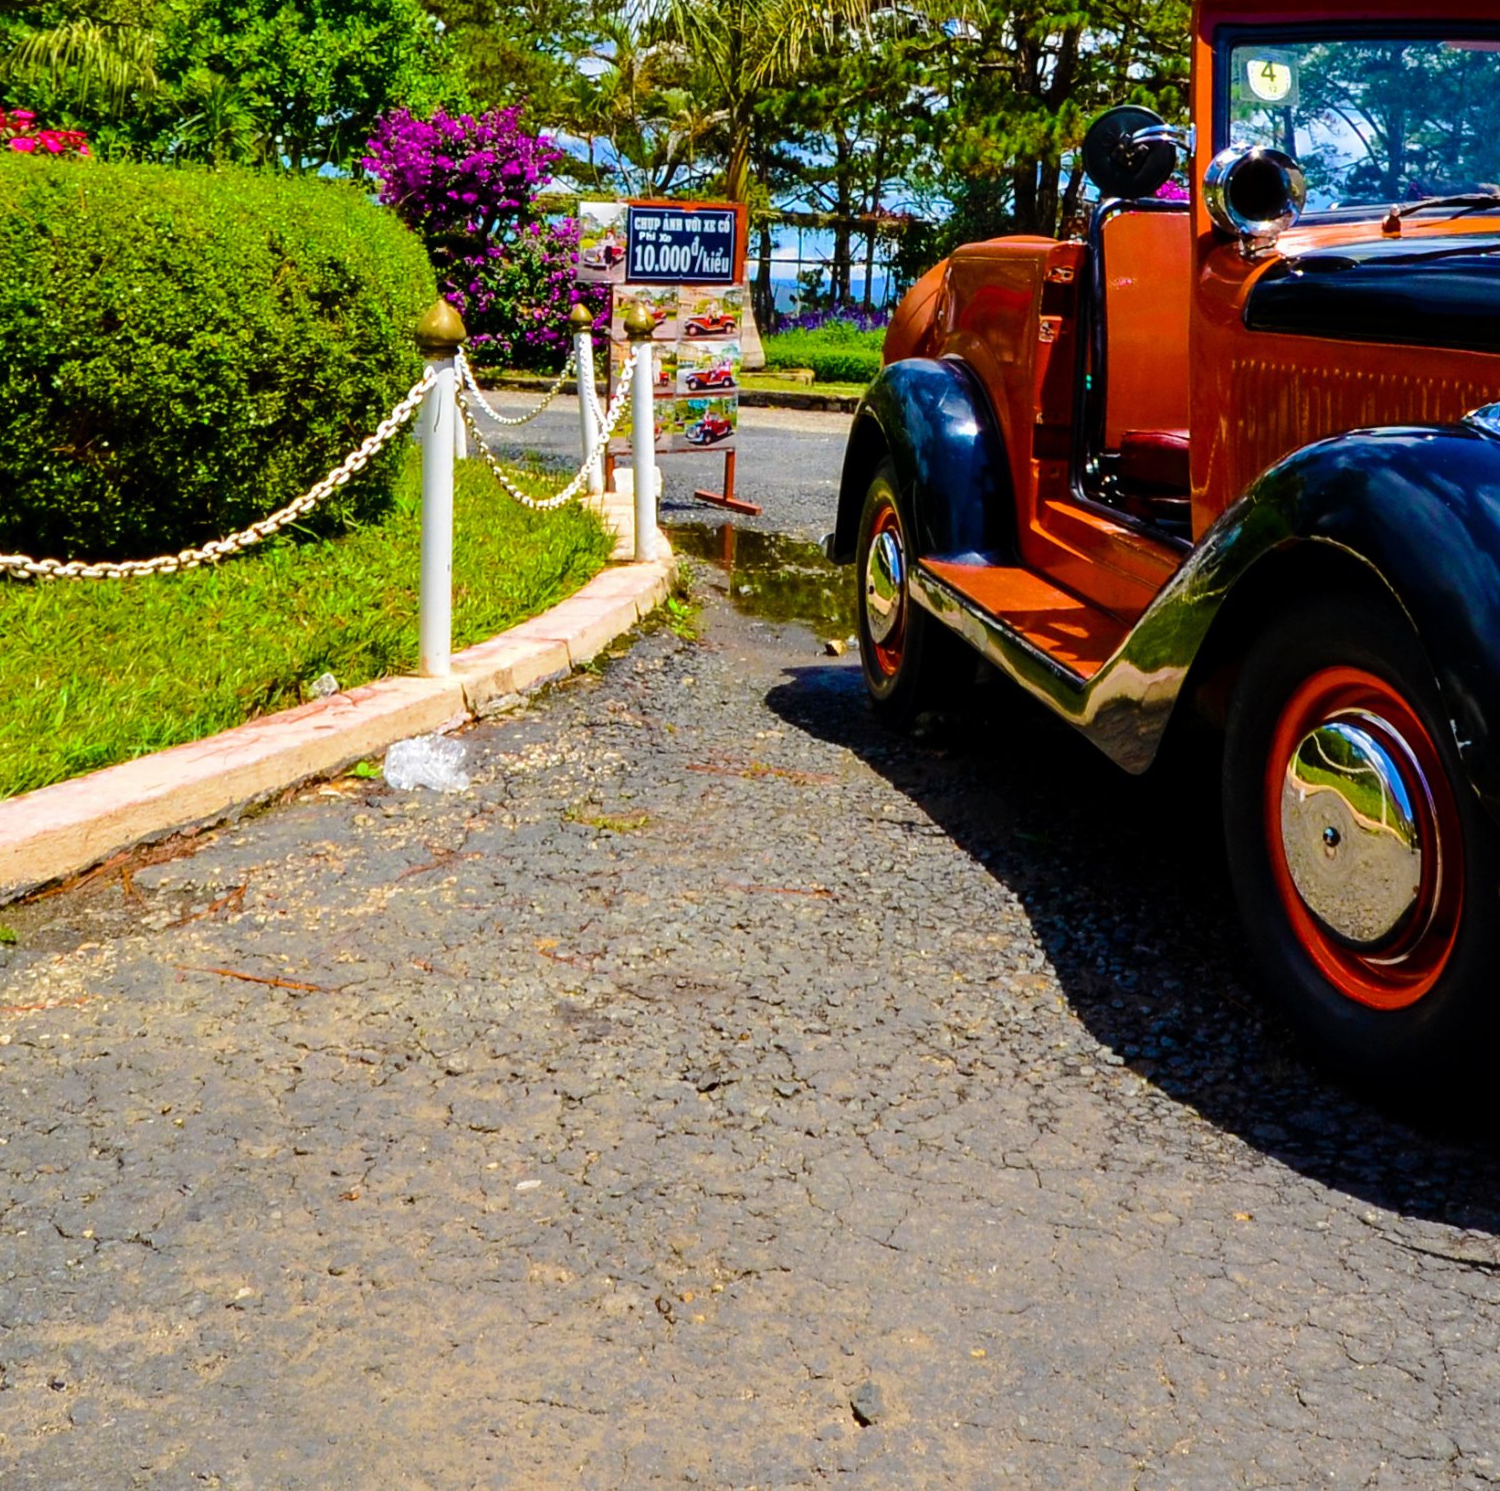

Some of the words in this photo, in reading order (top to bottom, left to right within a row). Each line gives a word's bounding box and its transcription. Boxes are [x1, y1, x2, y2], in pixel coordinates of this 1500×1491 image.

[1261, 61, 1276, 82] 4
[662, 213, 683, 231] ẢNH
[703, 219, 716, 233] XE
